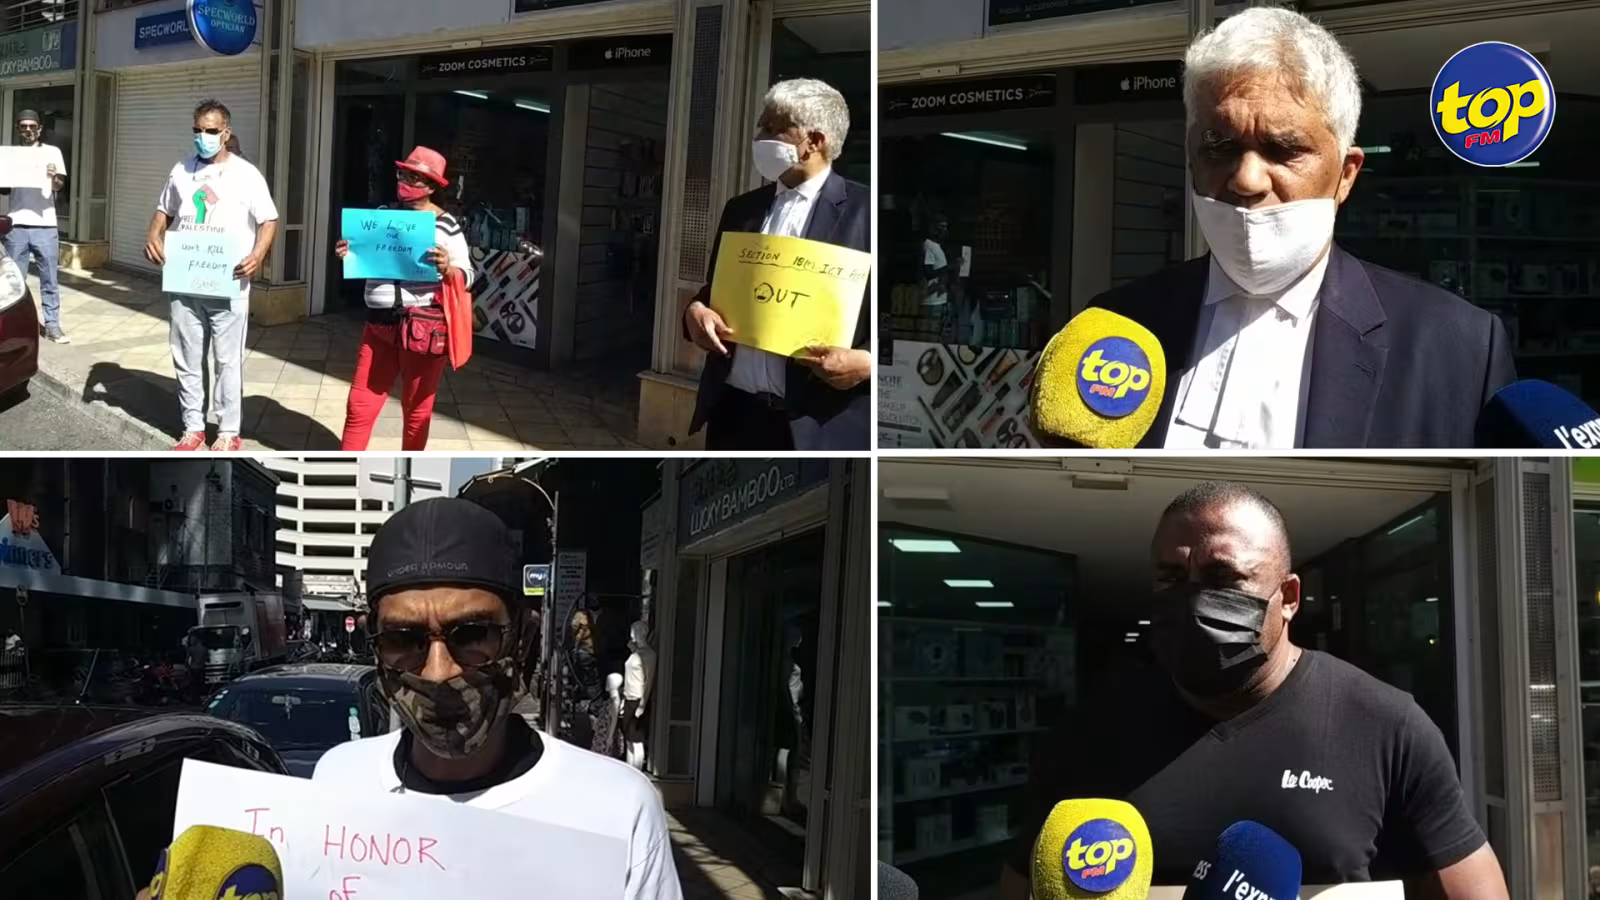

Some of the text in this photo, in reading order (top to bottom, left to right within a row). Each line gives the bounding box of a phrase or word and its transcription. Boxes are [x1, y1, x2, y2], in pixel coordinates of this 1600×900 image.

[198, 4, 255, 26] SPECWORLD
[139, 20, 189, 39] SPECWORL
[210, 20, 246, 33] OPTICIAN
[615, 47, 651, 58] iPhone
[438, 56, 526, 72] ZOOM COSMETICS
[1133, 76, 1176, 90] iPhone
[911, 88, 1023, 108] ZOOM COSMETICS
[738, 248, 780, 261] SECTION
[819, 263, 844, 276] ICT
[754, 282, 810, 309] OUT
[1081, 349, 1150, 399] top
[1089, 384, 1117, 397] FM
[689, 499, 723, 536] LUCKY
[721, 465, 781, 520] BAMBOO
[421, 562, 468, 572] ARMOUR
[1281, 769, 1334, 794] Lee Cooper
[324, 824, 446, 871] HONOR
[1065, 837, 1134, 875] top
[1081, 866, 1105, 879] FM
